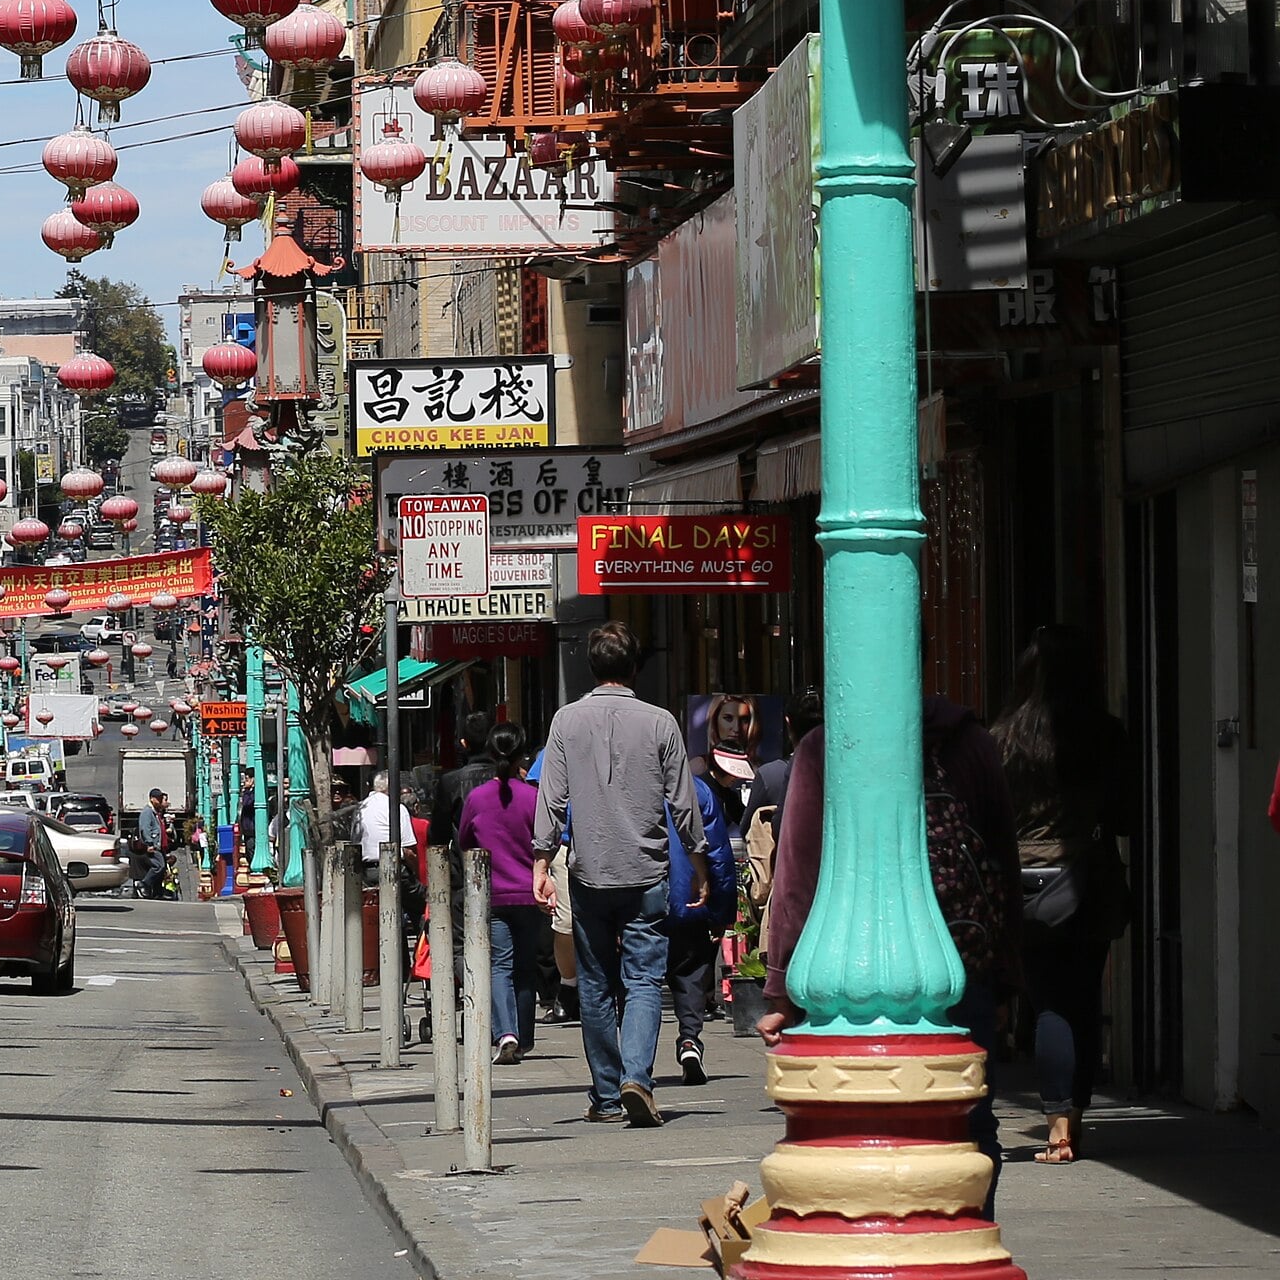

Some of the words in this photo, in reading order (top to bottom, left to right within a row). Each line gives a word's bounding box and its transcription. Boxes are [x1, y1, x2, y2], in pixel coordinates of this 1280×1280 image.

[426, 155, 601, 201] BAZAAR
[399, 213, 489, 232] DISCOUNT
[498, 212, 580, 232] IMPORTS
[362, 363, 546, 423] 昌記棧
[371, 429, 439, 444] CHONG
[450, 427, 487, 441] KEE
[496, 426, 536, 441] JAN
[405, 499, 481, 513] TOW-AWAY
[533, 489, 569, 514] OF
[402, 515, 425, 538] NO
[427, 519, 483, 537] STOPPING
[490, 524, 572, 537] RESTAURANT
[591, 525, 683, 551] FINAL
[692, 524, 778, 550] DAYS!
[428, 542, 461, 559] ANY
[490, 554, 515, 567] FFEE
[517, 554, 546, 567] SHOP
[593, 559, 696, 575] EVERYTHING
[700, 559, 746, 574] MUST
[750, 559, 774, 575] GO
[426, 562, 464, 579] TIME
[97, 585, 108, 594] of
[167, 576, 194, 587] China
[416, 598, 472, 616] TRADE
[478, 593, 547, 616] CENTER
[452, 626, 504, 644] MAGGIE'S
[508, 624, 538, 641] CAFE
[34, 667, 75, 682] FedEx
[204, 704, 247, 718] Washing
